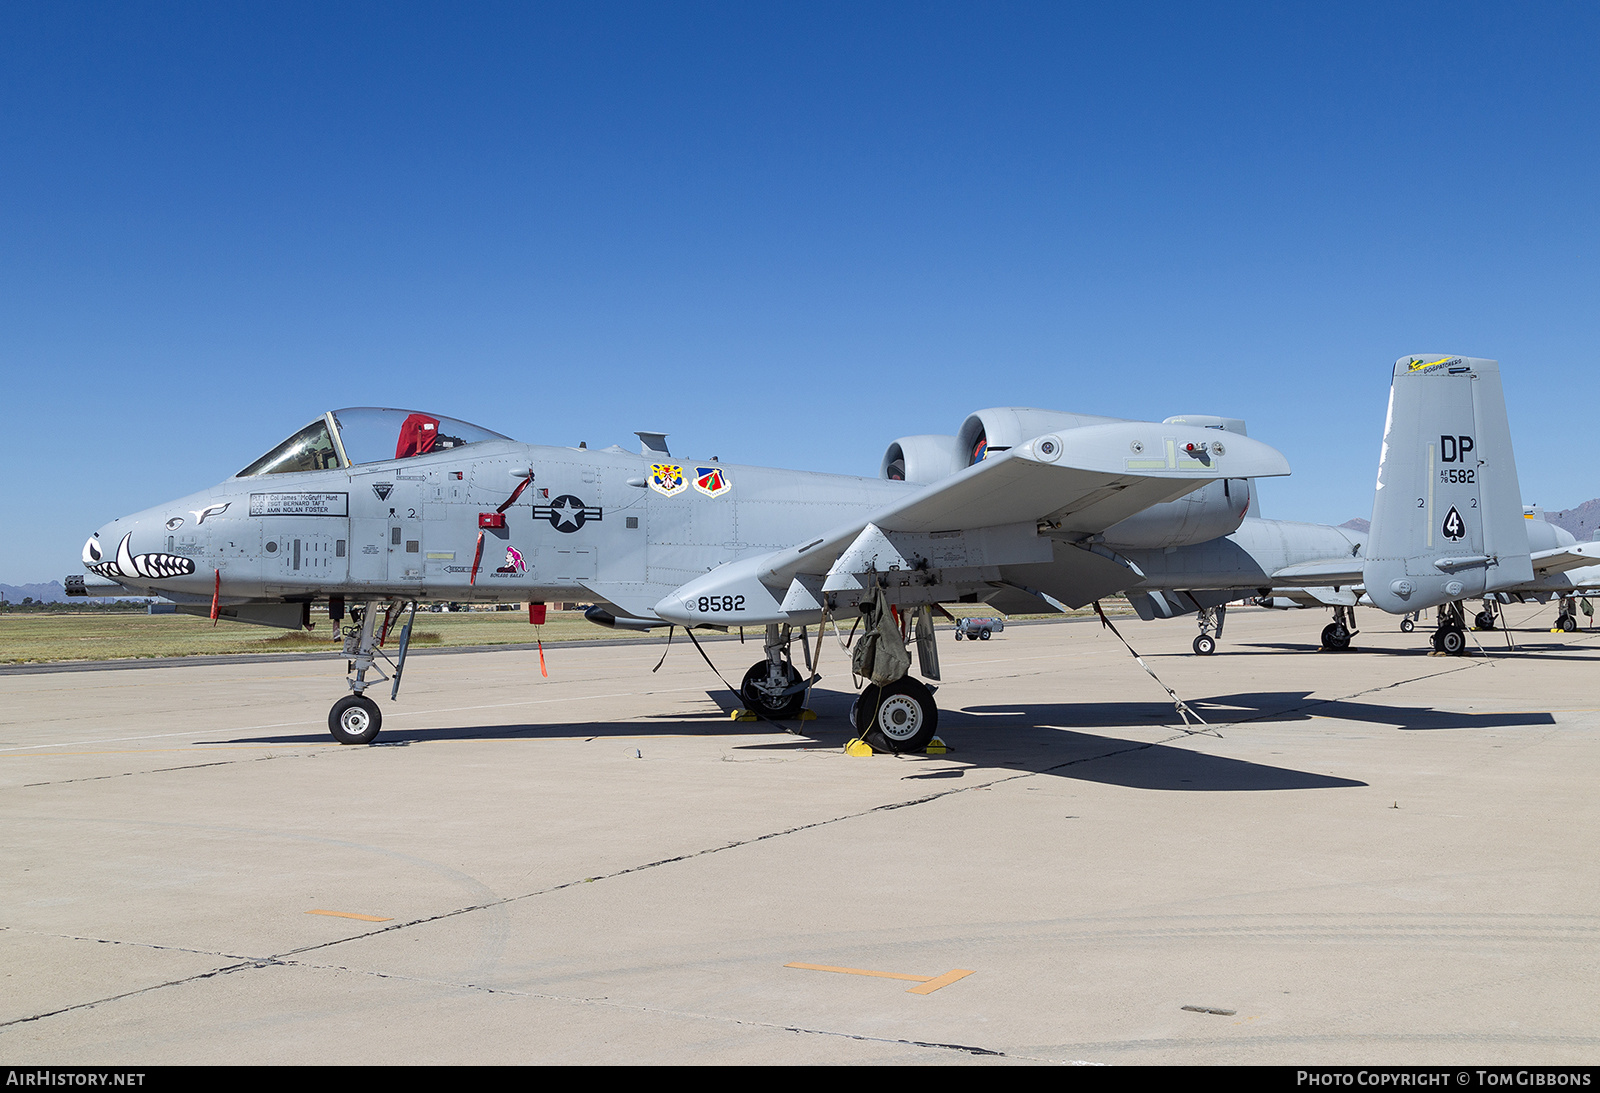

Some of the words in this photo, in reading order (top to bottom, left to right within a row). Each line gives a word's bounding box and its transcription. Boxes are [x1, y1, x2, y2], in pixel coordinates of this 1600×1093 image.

[1423, 358, 1462, 374] DOGPATCHERS
[1440, 435, 1474, 463] DP
[1449, 469, 1475, 484] 582
[1417, 498, 1425, 508] 2
[1470, 498, 1477, 508] 2
[407, 508, 416, 518] 2
[1447, 512, 1459, 535] 4
[698, 595, 746, 613] 8582
